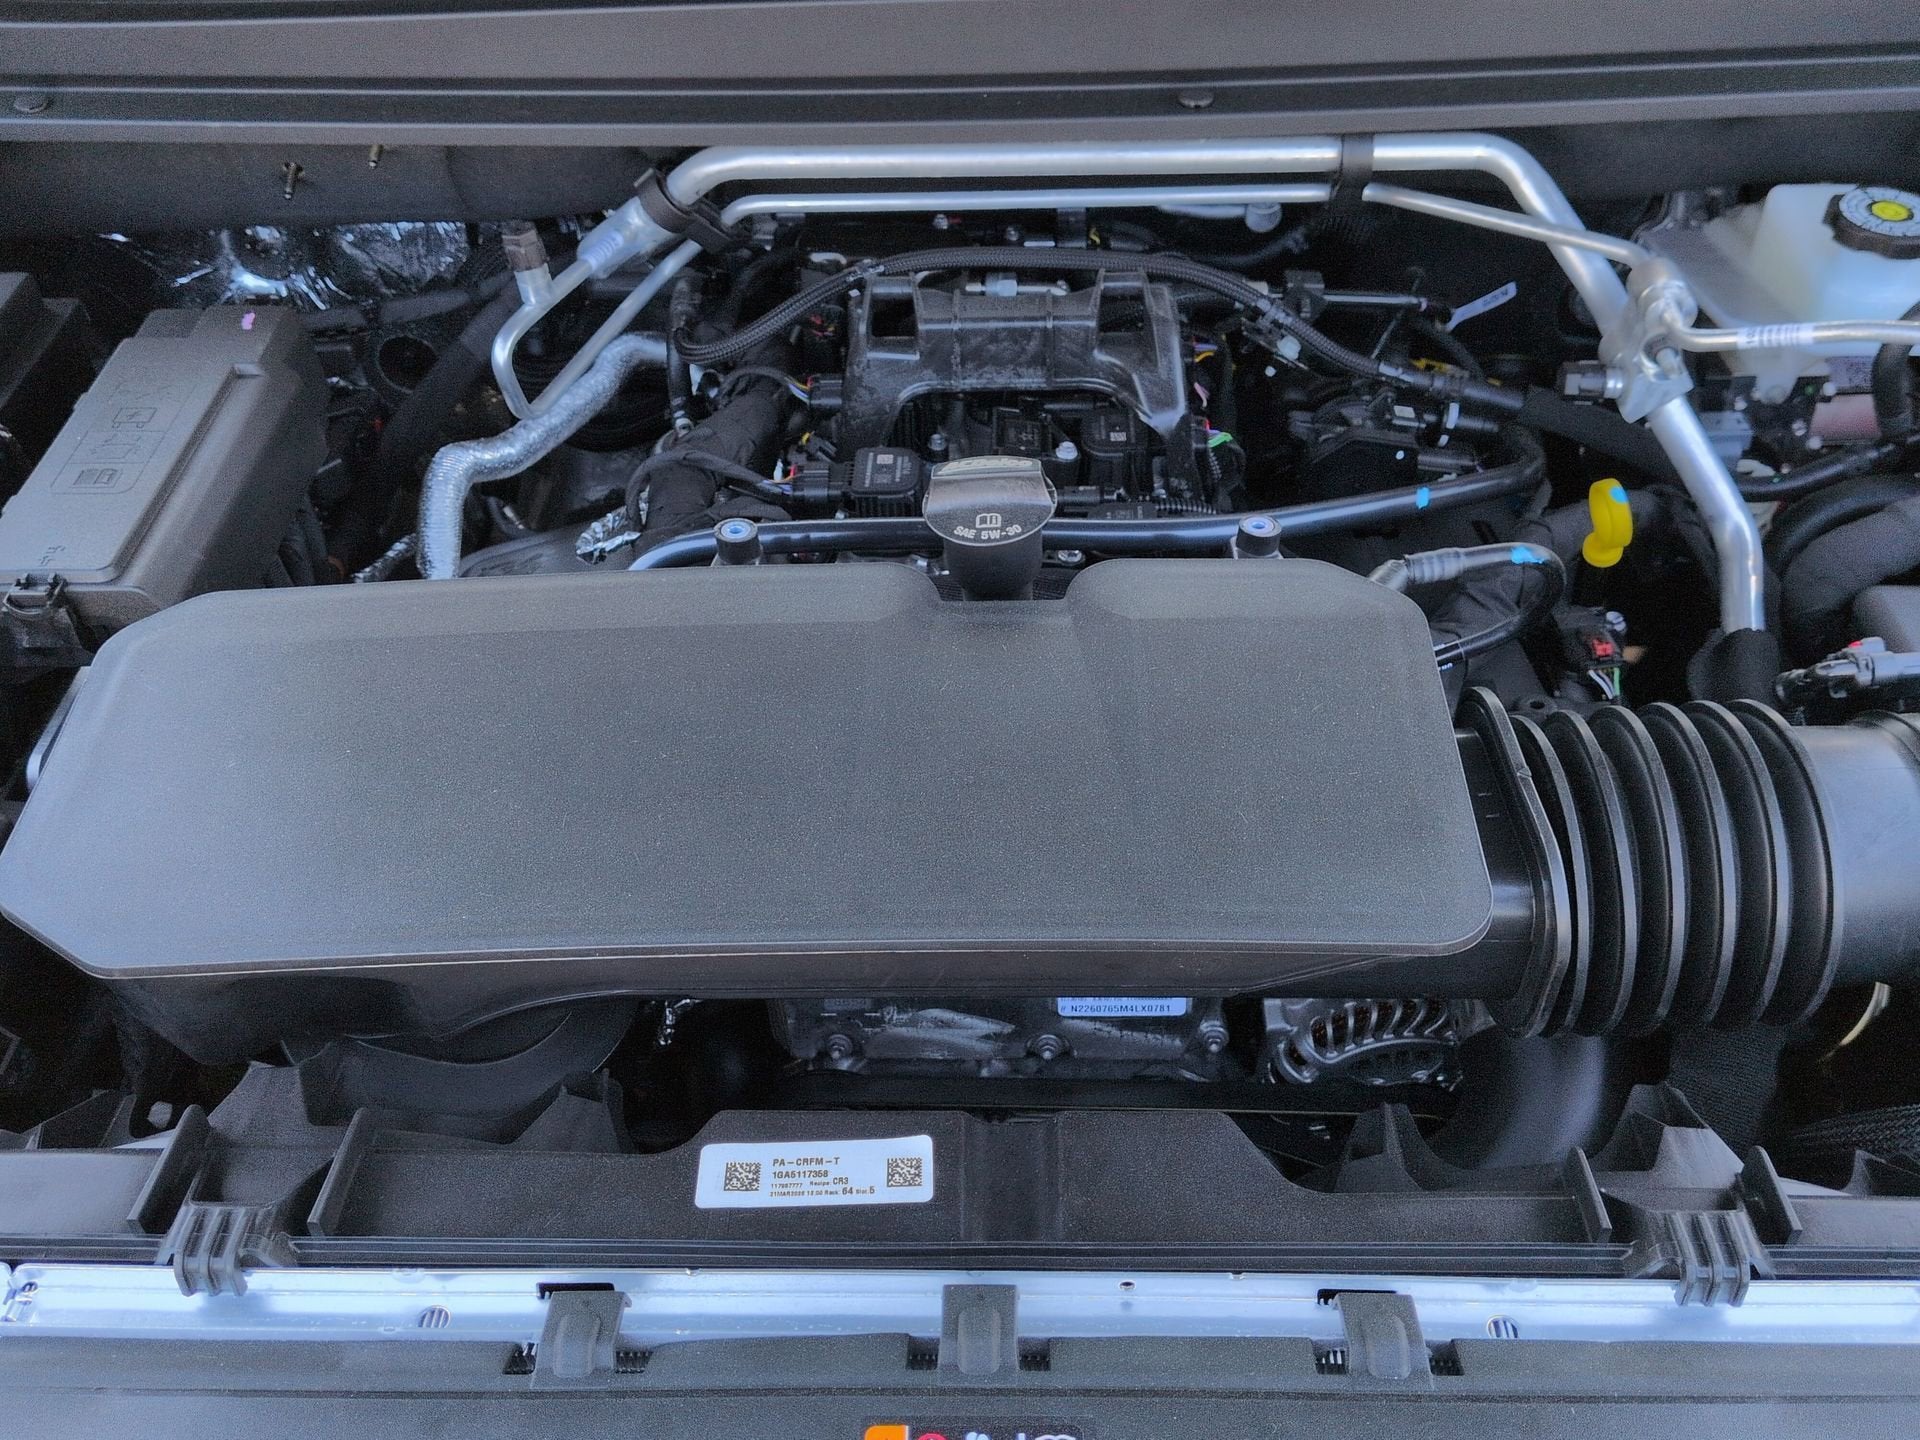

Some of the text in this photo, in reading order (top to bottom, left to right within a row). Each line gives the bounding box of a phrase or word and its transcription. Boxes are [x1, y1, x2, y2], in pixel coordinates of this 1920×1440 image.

[953, 524, 1022, 540] SAE 5W-30
[832, 1177, 849, 1185] CR3
[842, 1186, 853, 1195] 64
[869, 1185, 876, 1194] 5
